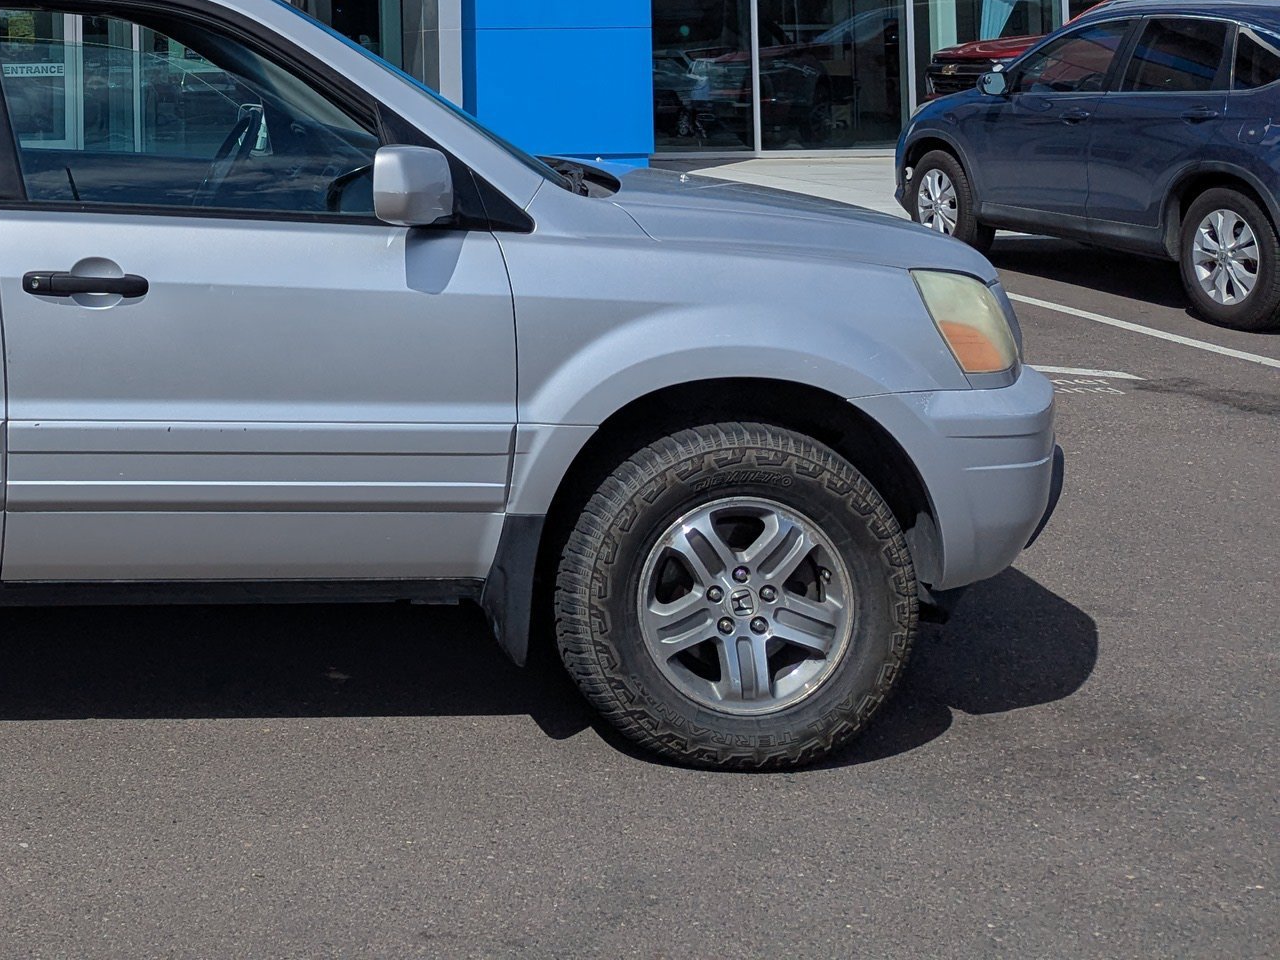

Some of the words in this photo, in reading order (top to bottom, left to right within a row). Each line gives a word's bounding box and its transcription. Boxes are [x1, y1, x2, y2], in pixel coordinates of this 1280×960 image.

[4, 65, 64, 74] ENTRANCE
[657, 701, 800, 748] TERRAIN
[807, 692, 856, 735] ALL
